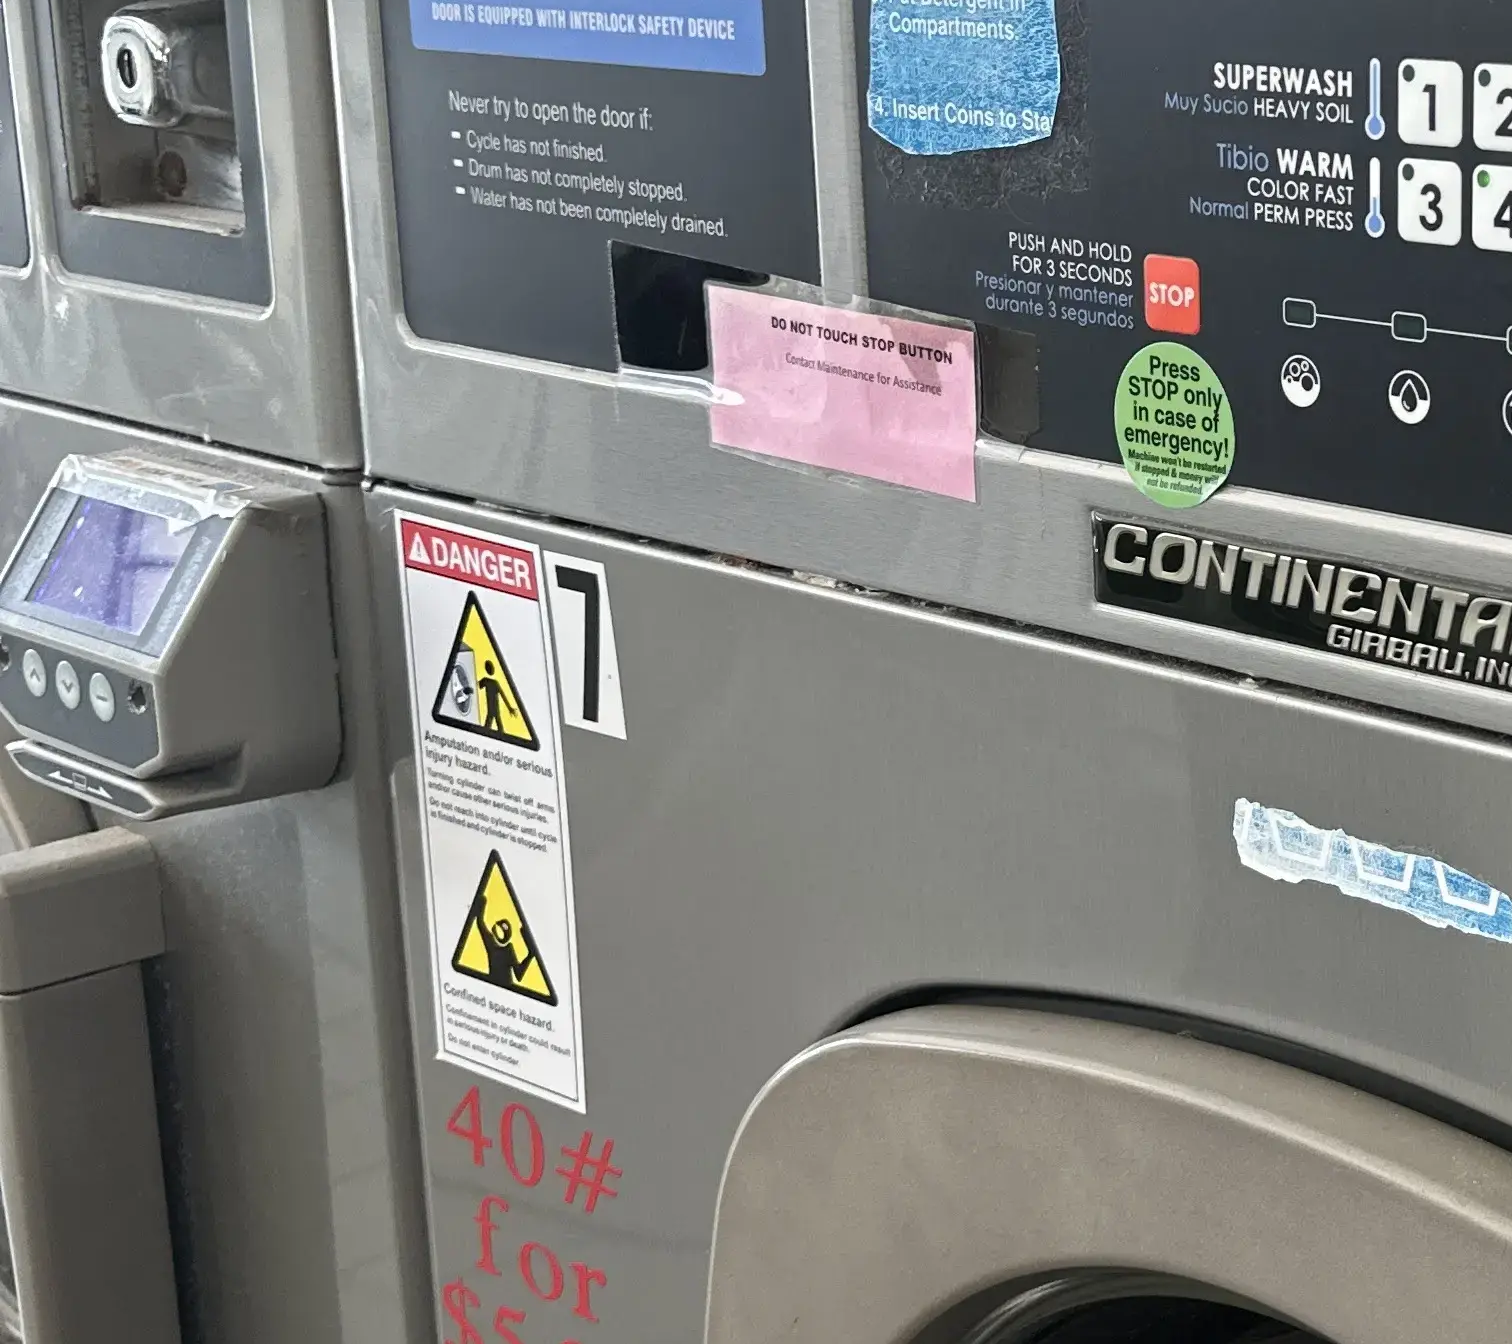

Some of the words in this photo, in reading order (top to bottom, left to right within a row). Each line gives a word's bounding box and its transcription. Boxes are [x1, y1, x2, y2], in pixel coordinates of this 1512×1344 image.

[432, 2, 461, 21] DOOR
[464, 4, 475, 23] IS
[478, 6, 533, 27] EQUIPPED
[536, 9, 566, 29] WITH
[570, 10, 635, 33] INTERLOCK
[639, 15, 683, 36] SAFETY
[688, 18, 735, 40] DEVICE
[889, 14, 1019, 40] Compartments.
[1214, 62, 1353, 98] SUPERWASH
[448, 90, 489, 115] Never
[493, 96, 511, 122] try
[515, 98, 528, 118] to
[533, 100, 569, 123] open
[572, 103, 597, 124] the
[600, 105, 635, 128] door
[639, 107, 653, 131] if:
[893, 98, 939, 122] Insert
[945, 104, 994, 127] Coins
[999, 109, 1016, 128] to
[1253, 97, 1310, 121] HEAVY
[1316, 101, 1354, 124] SOIL
[1422, 84, 1437, 132] 1
[466, 130, 500, 153] Cycle
[504, 134, 527, 154] has
[530, 137, 550, 157] not
[553, 139, 607, 163] finished.
[1216, 143, 1269, 173] Tibio
[1278, 148, 1353, 180] WARM
[1247, 178, 1310, 202] COLOR
[1316, 183, 1354, 205] FAST
[1419, 183, 1444, 231] 3
[1190, 197, 1248, 221] Normal
[1253, 202, 1300, 226] PERM
[1305, 208, 1354, 232] PRESS
[1009, 231, 1046, 253] PUSH
[1051, 237, 1085, 259] AND
[1089, 241, 1132, 263] HOLD
[1012, 254, 1042, 275] FOR
[1046, 259, 1056, 277] 3
[1060, 260, 1133, 287] SECONDS
[1149, 282, 1195, 308] STOP
[771, 316, 787, 332] DO
[791, 318, 813, 337] NOT
[817, 323, 858, 347] TOUCH
[862, 335, 895, 354] STOP
[899, 341, 953, 366] BUTTON
[1150, 355, 1201, 382] Press
[1129, 376, 1179, 400] STOP
[1184, 387, 1222, 414] only
[1133, 401, 1149, 422] in
[1154, 408, 1196, 429] case
[1202, 414, 1219, 433] of
[1124, 427, 1228, 461] emergency!
[431, 536, 531, 590] DANGER
[555, 564, 600, 723] 7
[445, 1085, 623, 1214] 40#
[473, 1195, 607, 1324] for
